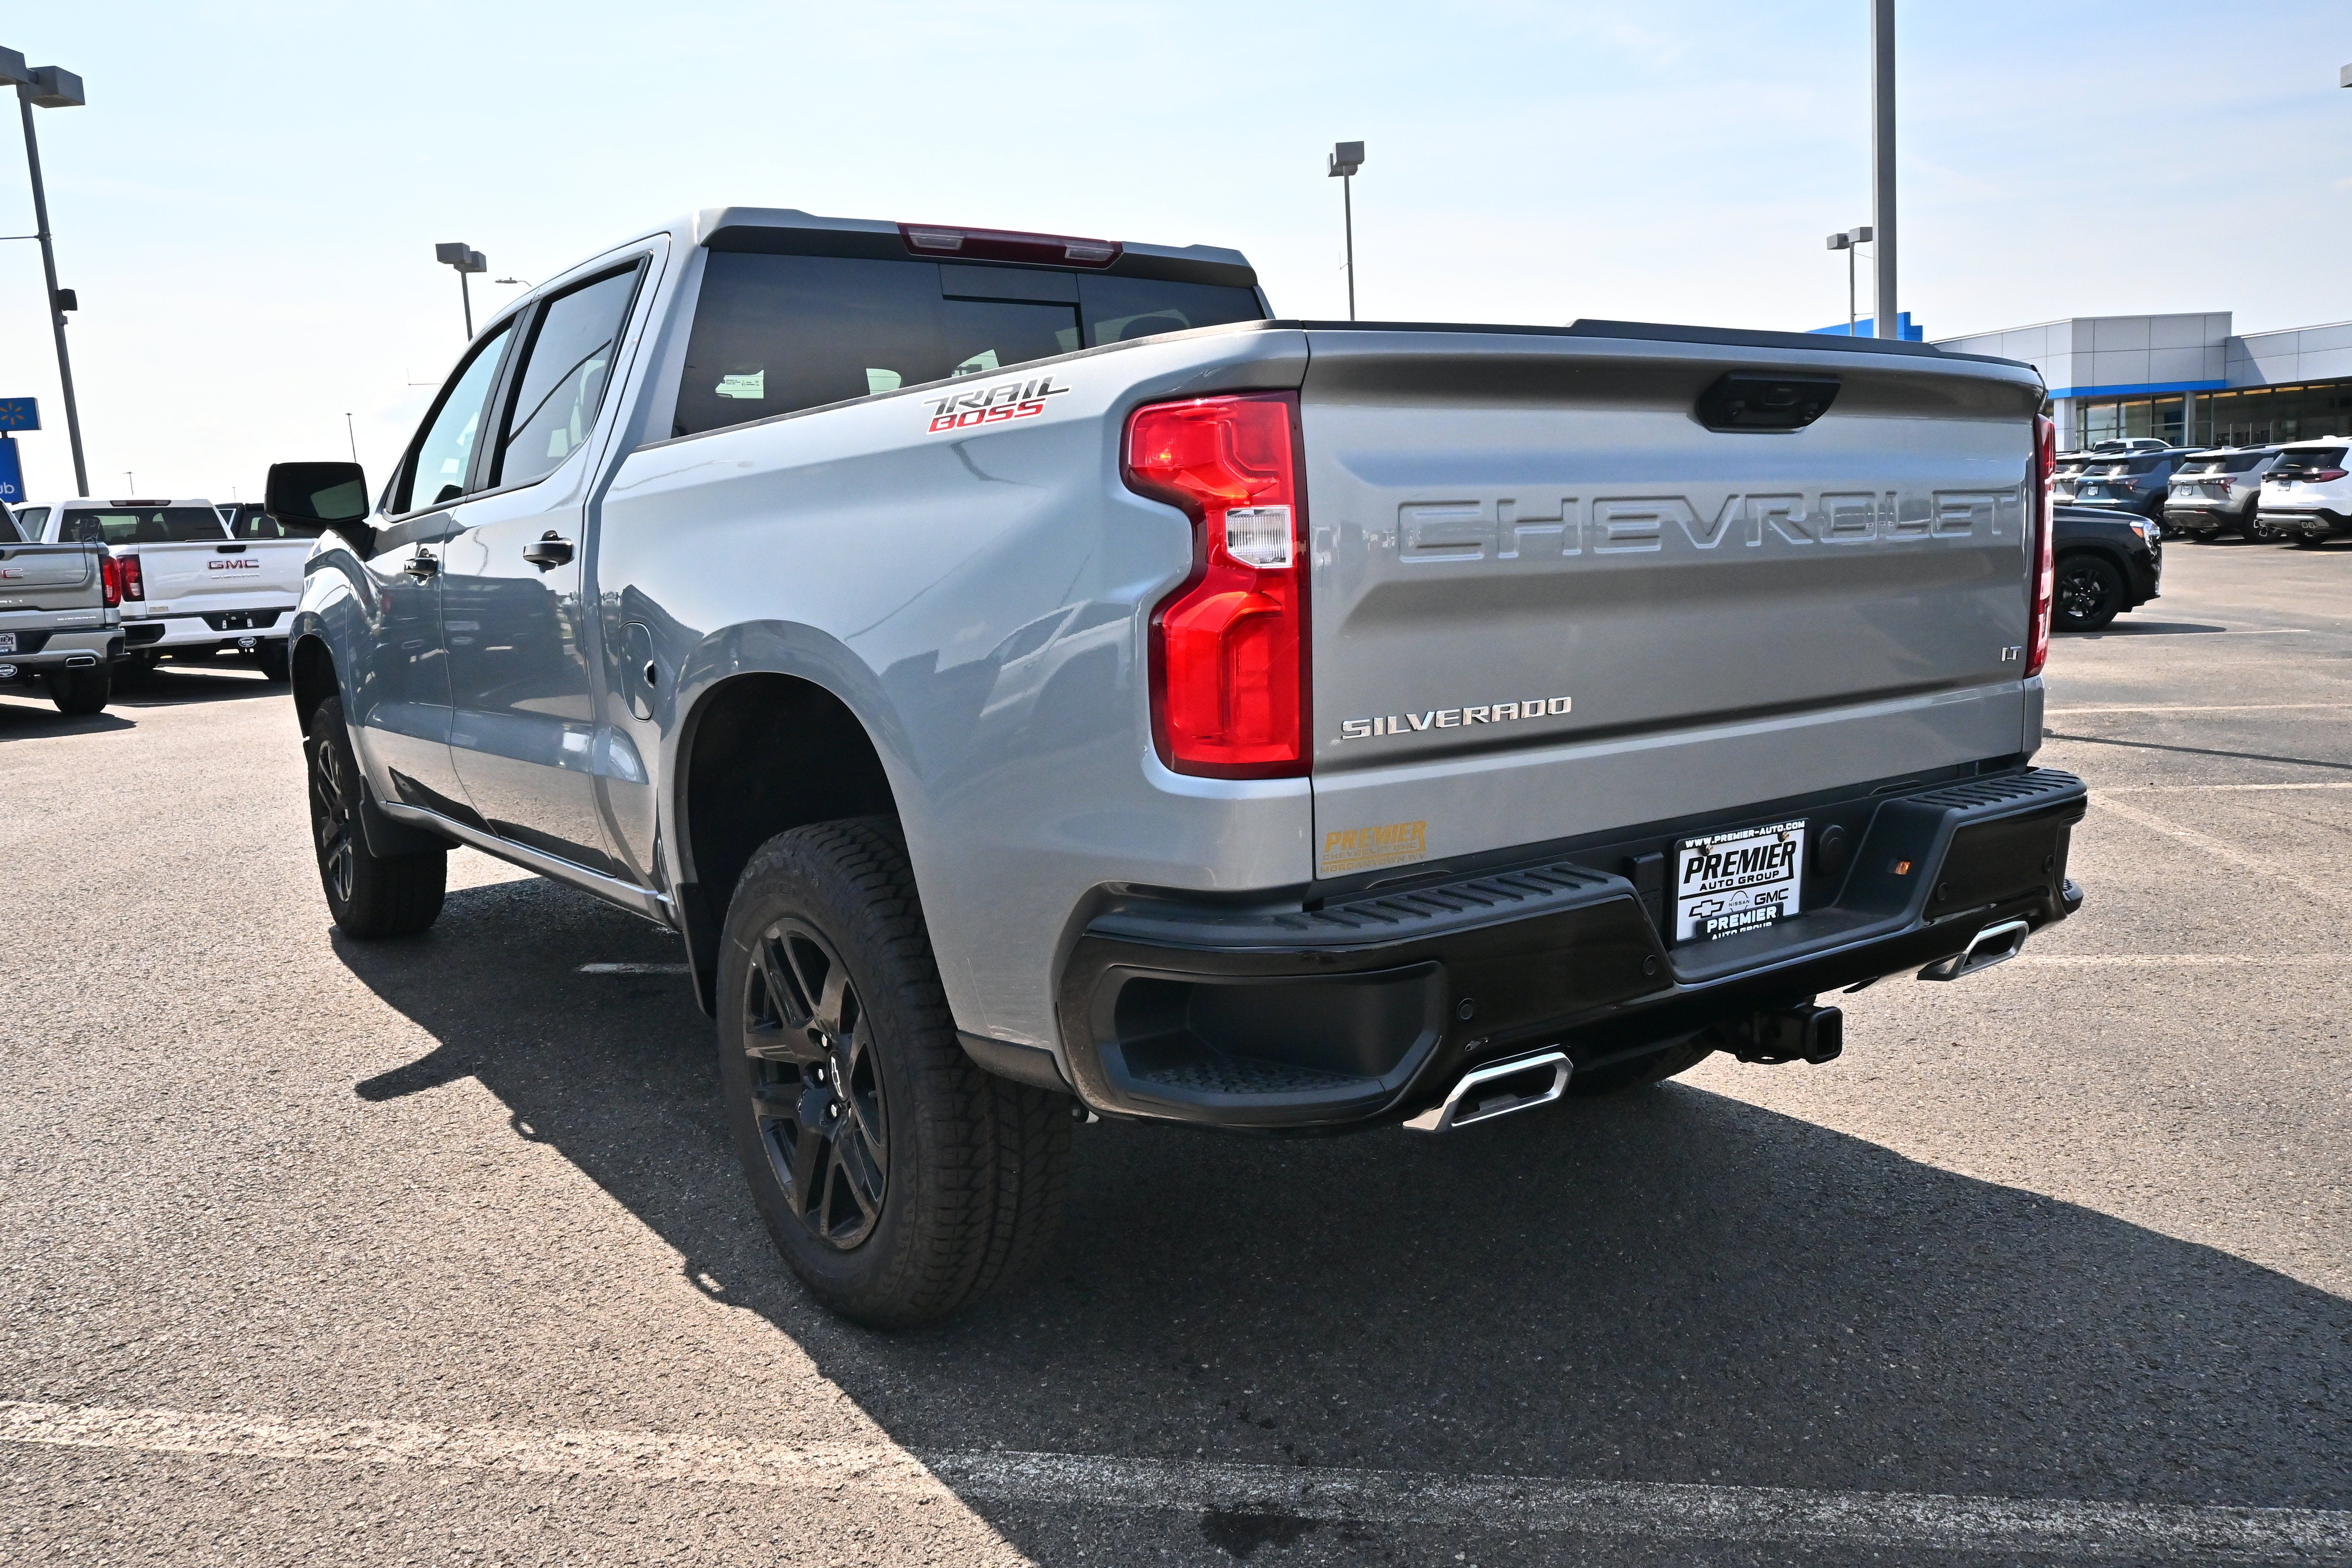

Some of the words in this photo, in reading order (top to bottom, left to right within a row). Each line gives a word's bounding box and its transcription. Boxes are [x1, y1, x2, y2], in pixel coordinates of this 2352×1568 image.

[924, 376, 1070, 415] TRAIL
[928, 398, 1046, 432] BOSS
[1398, 489, 2017, 563] CHEVROLET
[208, 559, 259, 569] GMC
[2001, 646, 2022, 662] LT
[1342, 697, 1571, 740] SILVERADO
[1324, 821, 1426, 852] PREMIER
[1685, 821, 1805, 848] WWW.PREMIER-AUTO.COM
[1683, 840, 1797, 884] PREMIER
[1699, 878, 1733, 891] AUTO
[1738, 870, 1779, 884] GROUP
[1754, 888, 1789, 905] GMC
[1707, 906, 1777, 933] PREMIER
